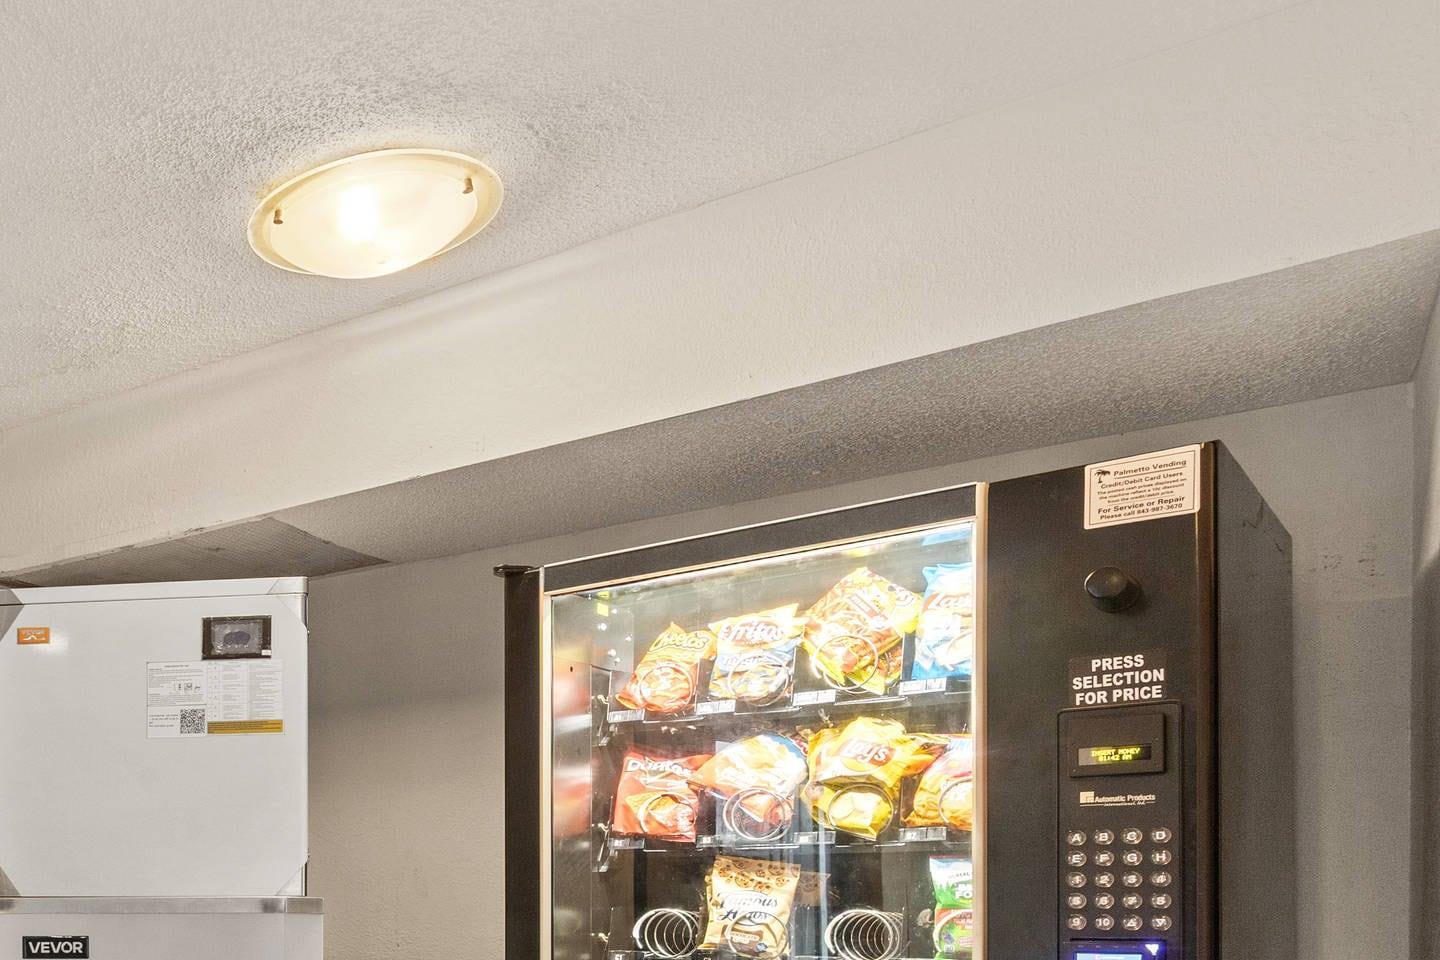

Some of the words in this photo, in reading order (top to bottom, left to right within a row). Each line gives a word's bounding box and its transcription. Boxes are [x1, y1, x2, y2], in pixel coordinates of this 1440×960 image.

[1114, 466, 1150, 477] Palmetto
[1152, 460, 1186, 470] Vending
[1100, 478, 1142, 489] Credit/Debit
[1113, 502, 1144, 512] Service
[1158, 496, 1185, 505] Repair
[722, 620, 784, 644] Fritos
[654, 632, 710, 650] Cheetos
[1091, 654, 1144, 672] PRESS
[1072, 668, 1165, 690] SELECTION
[1075, 691, 1108, 705] FOR
[1113, 685, 1162, 702] PRICE
[629, 760, 693, 777] Doritos
[28, 941, 83, 954] VEVOR
